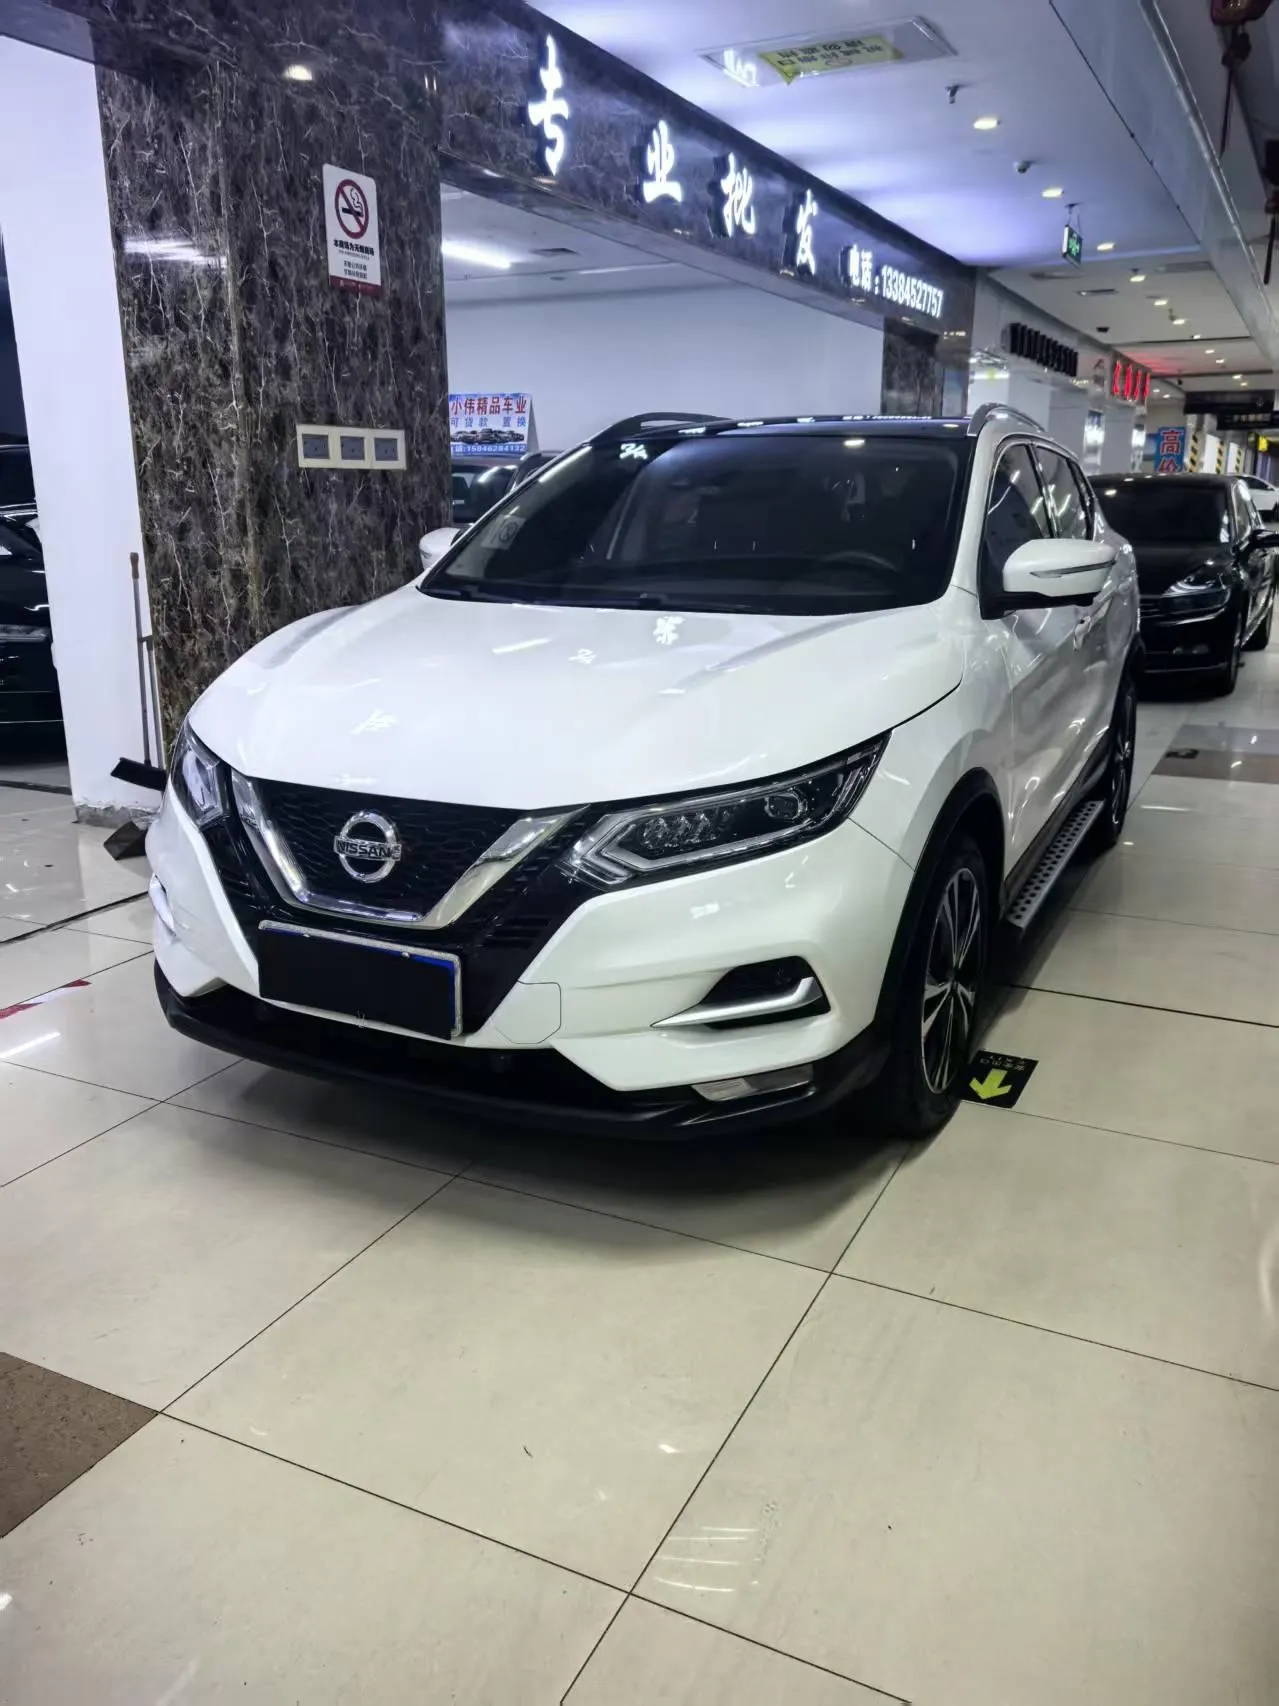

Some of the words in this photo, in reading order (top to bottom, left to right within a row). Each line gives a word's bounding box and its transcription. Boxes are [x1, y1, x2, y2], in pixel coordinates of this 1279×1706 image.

[451, 395, 527, 416] 小伟精品车业
[336, 839, 392, 859] NISSAN
